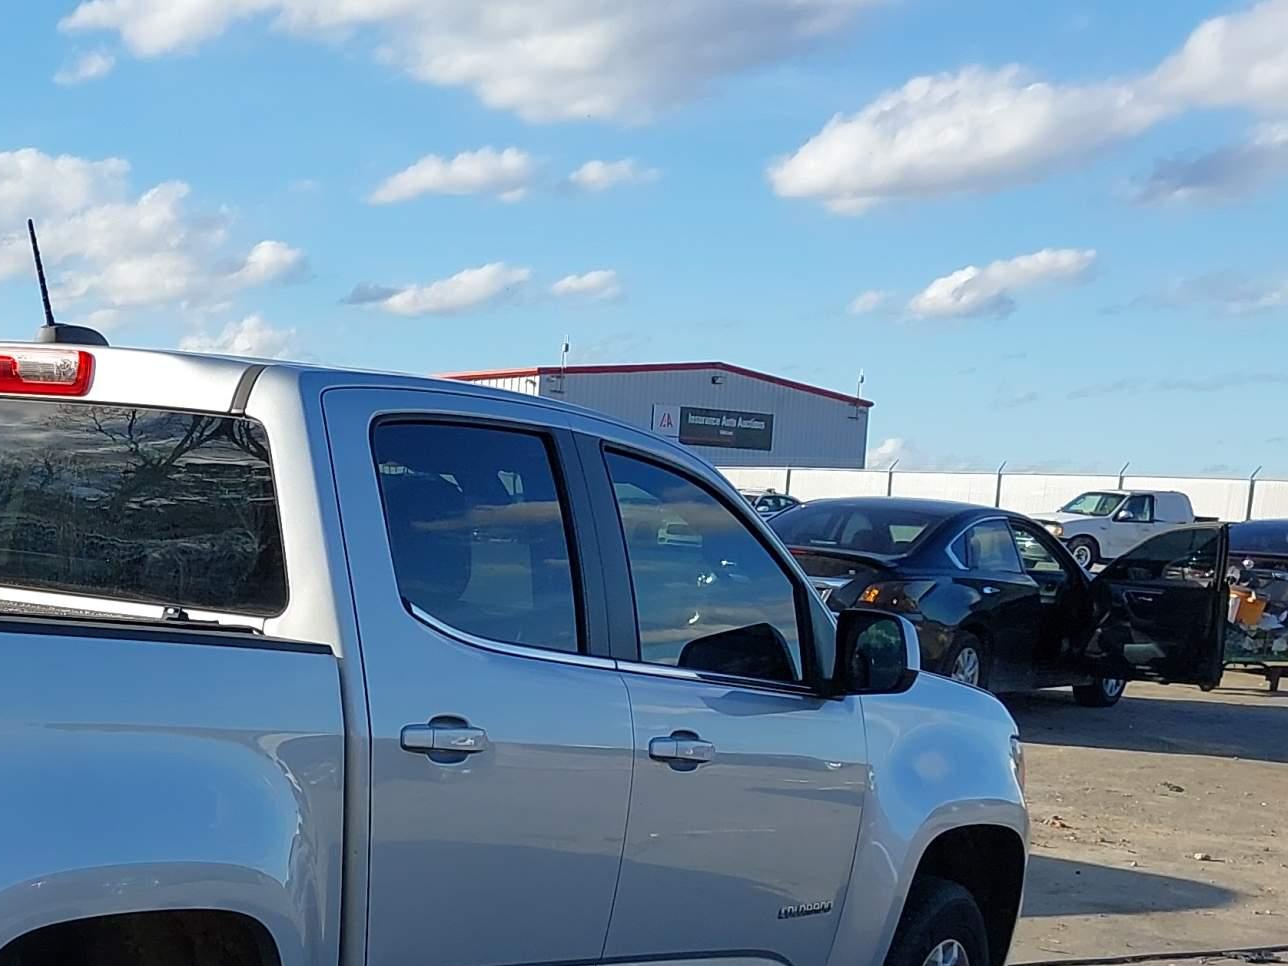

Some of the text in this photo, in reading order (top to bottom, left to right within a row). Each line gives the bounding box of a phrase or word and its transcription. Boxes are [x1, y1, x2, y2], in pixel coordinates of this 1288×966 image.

[688, 412, 766, 430] Insurance Auto Auctions
